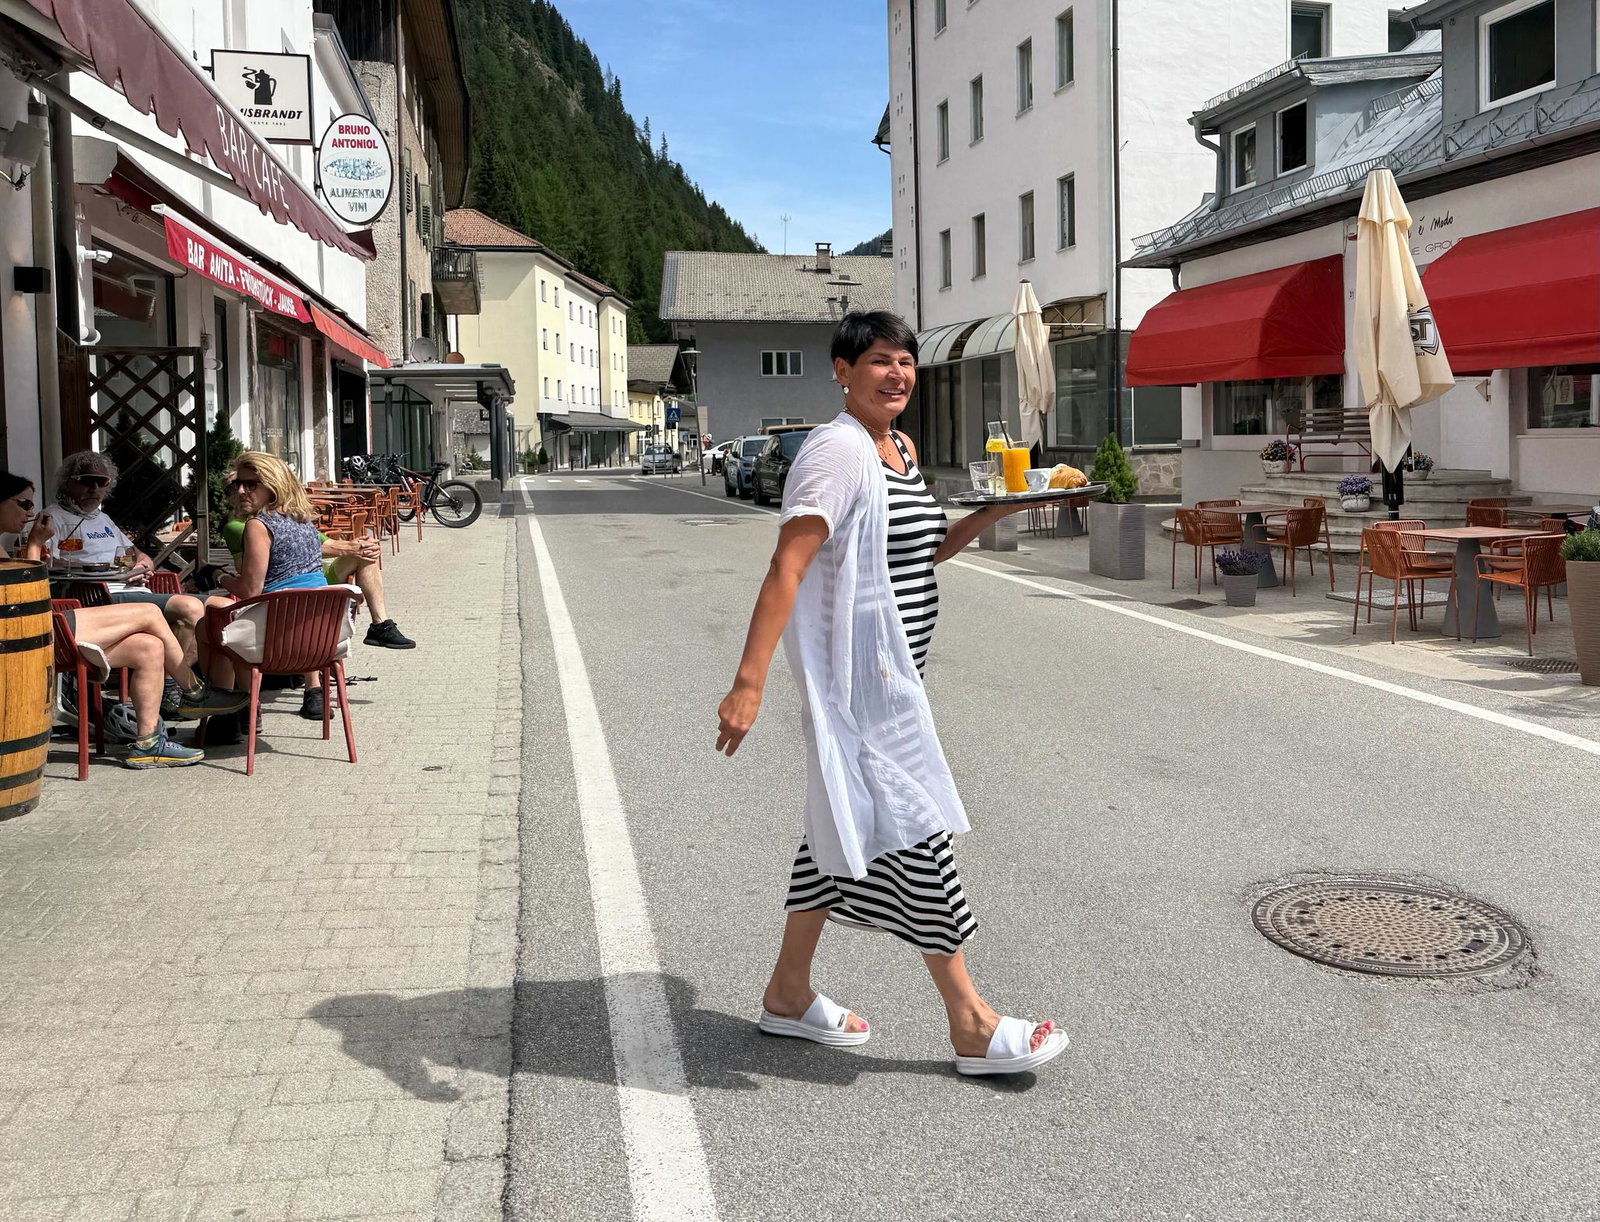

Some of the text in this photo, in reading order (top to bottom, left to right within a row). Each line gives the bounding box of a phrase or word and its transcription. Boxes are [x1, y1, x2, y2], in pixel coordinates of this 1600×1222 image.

[338, 124, 371, 135] BRUNO
[215, 103, 250, 179] BAR
[331, 138, 379, 149] ANTONIOL
[330, 188, 385, 199] ALIMENTARI
[348, 201, 368, 213] VINI
[186, 237, 205, 271] BAR
[209, 251, 236, 286] ANITA
[277, 291, 298, 317] JAUSE
